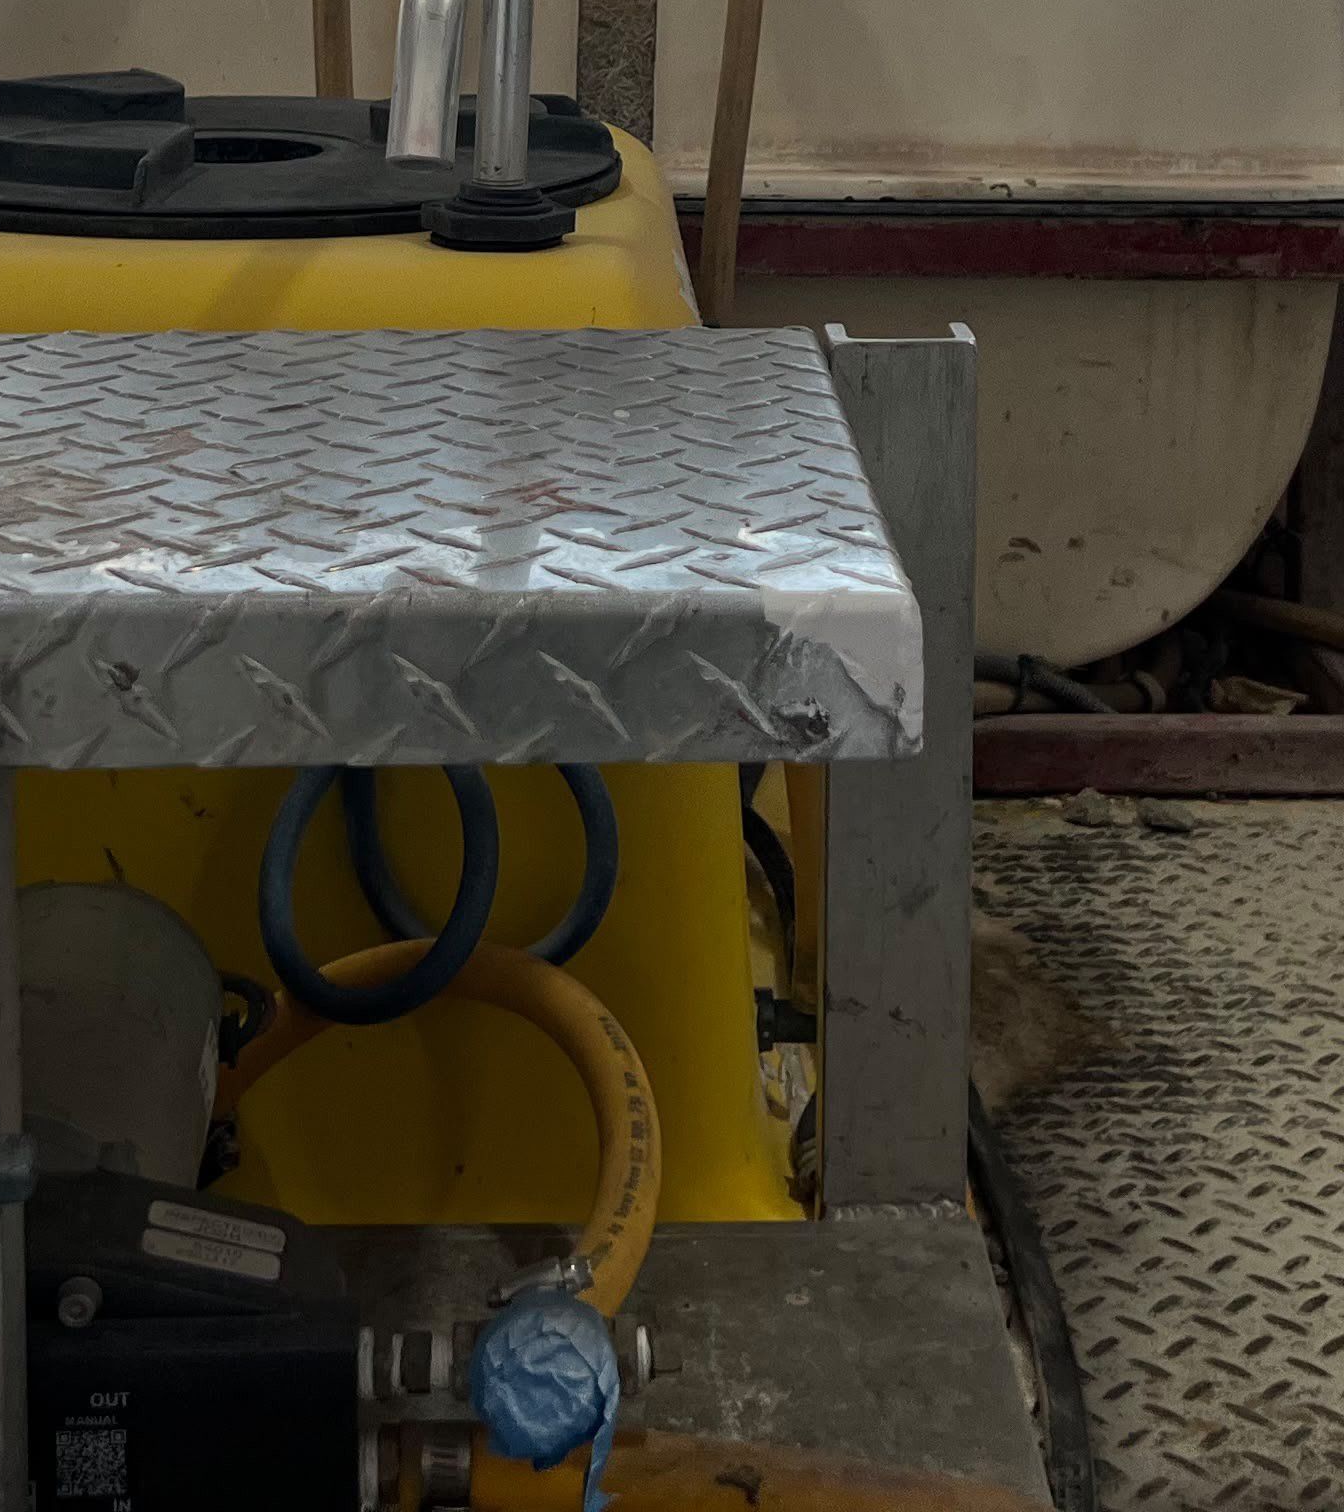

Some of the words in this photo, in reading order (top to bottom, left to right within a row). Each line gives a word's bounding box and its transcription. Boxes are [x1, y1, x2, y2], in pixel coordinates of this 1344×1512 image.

[89, 1391, 131, 1408] OUT
[64, 1415, 119, 1426] MANUAL
[112, 1497, 132, 1512] IN
